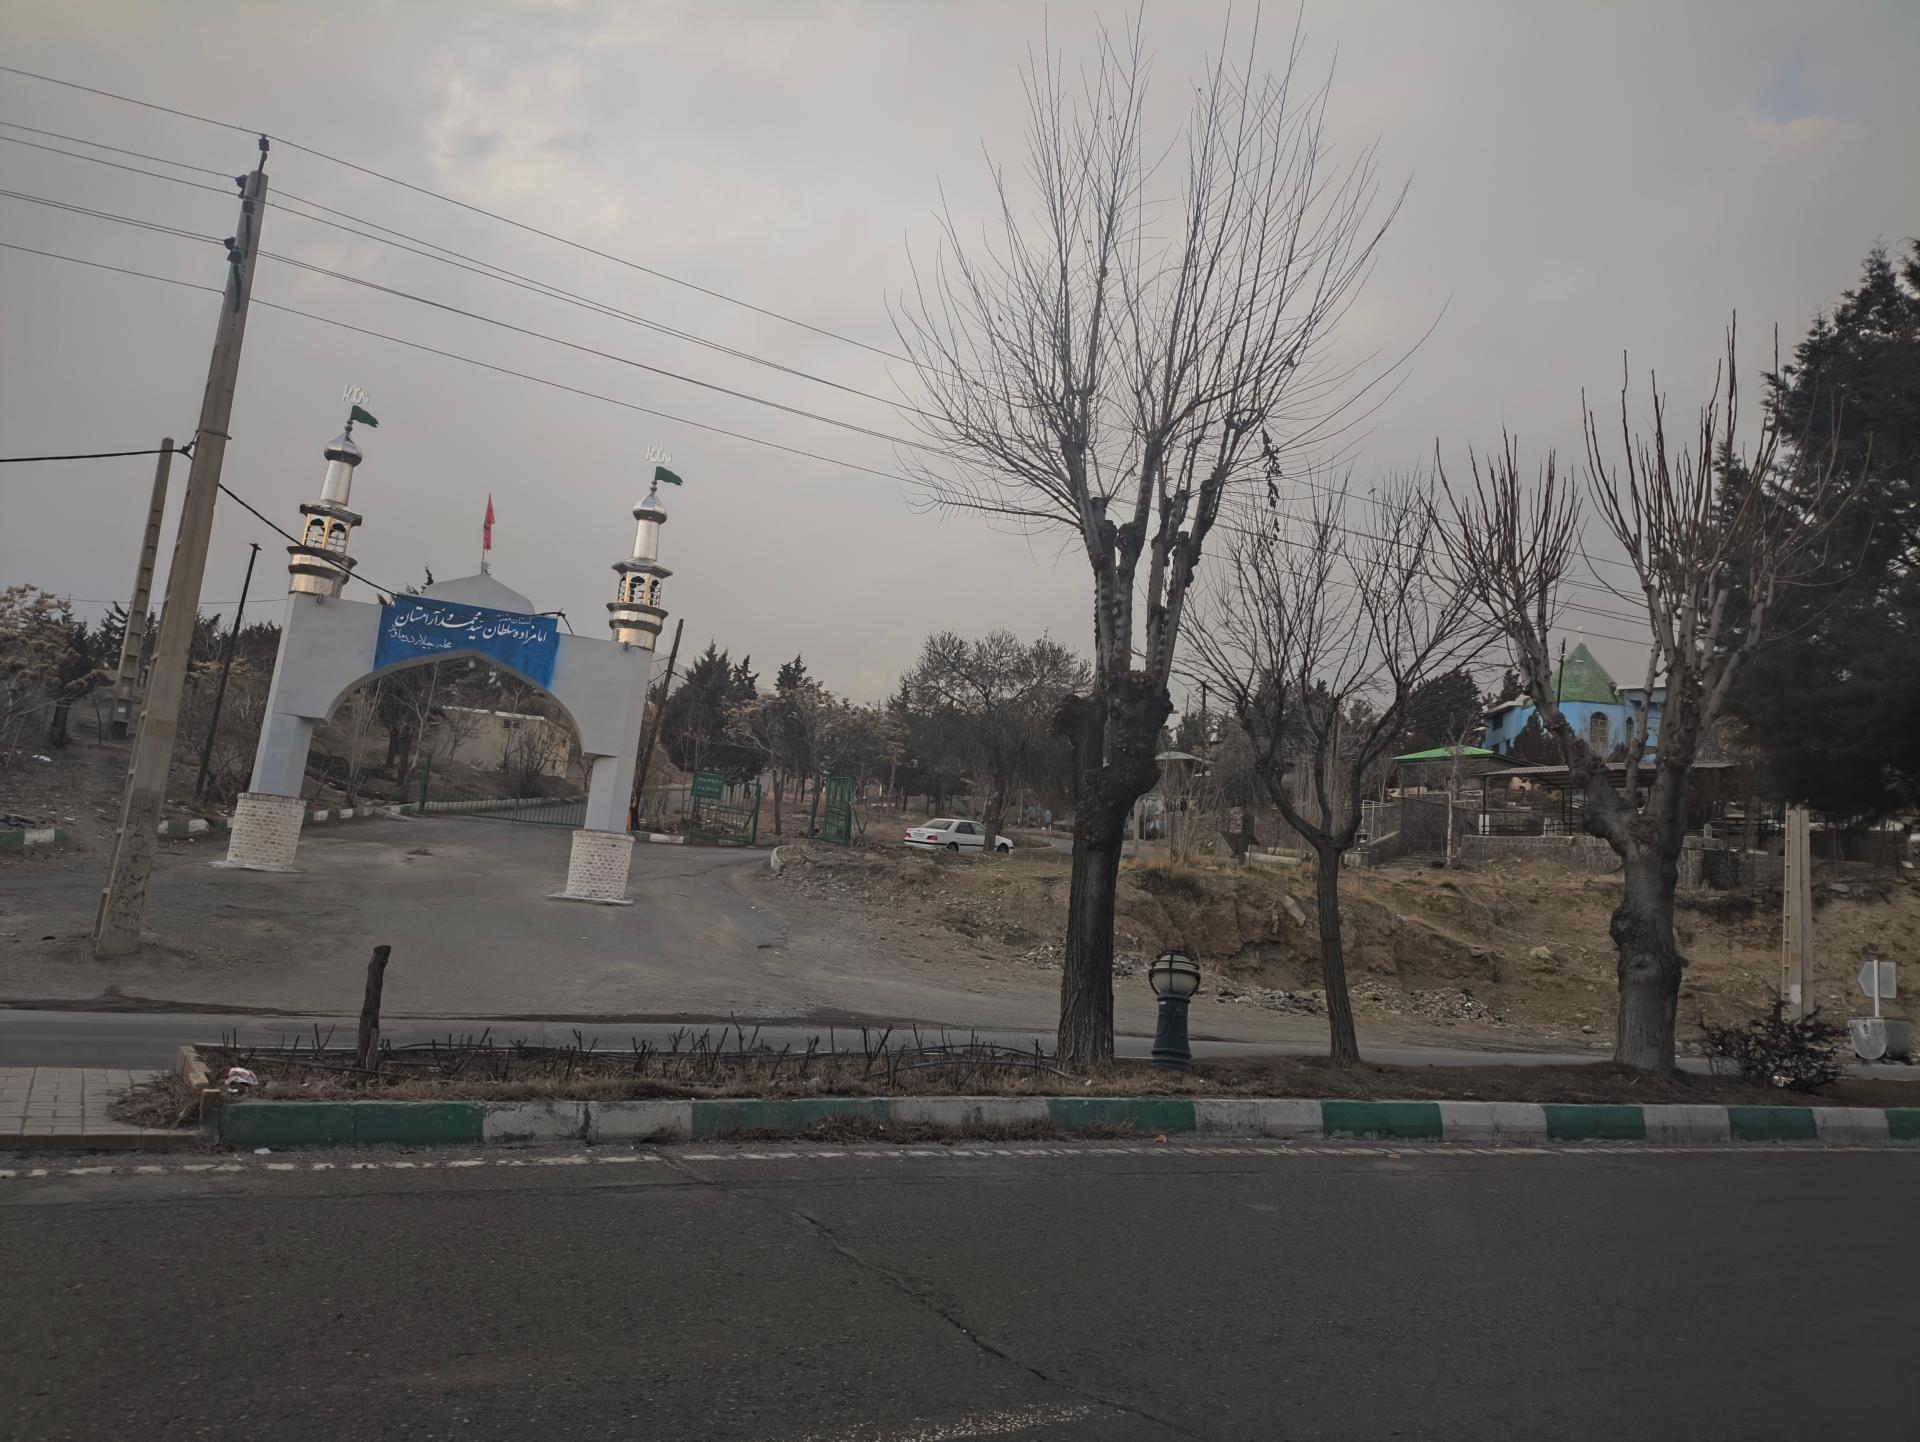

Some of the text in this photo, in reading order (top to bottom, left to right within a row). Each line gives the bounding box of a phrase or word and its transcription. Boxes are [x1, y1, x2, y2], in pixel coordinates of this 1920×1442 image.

[394, 605, 442, 627] آرامستان
[436, 611, 482, 628] محمد
[482, 623, 517, 639] سلطان
